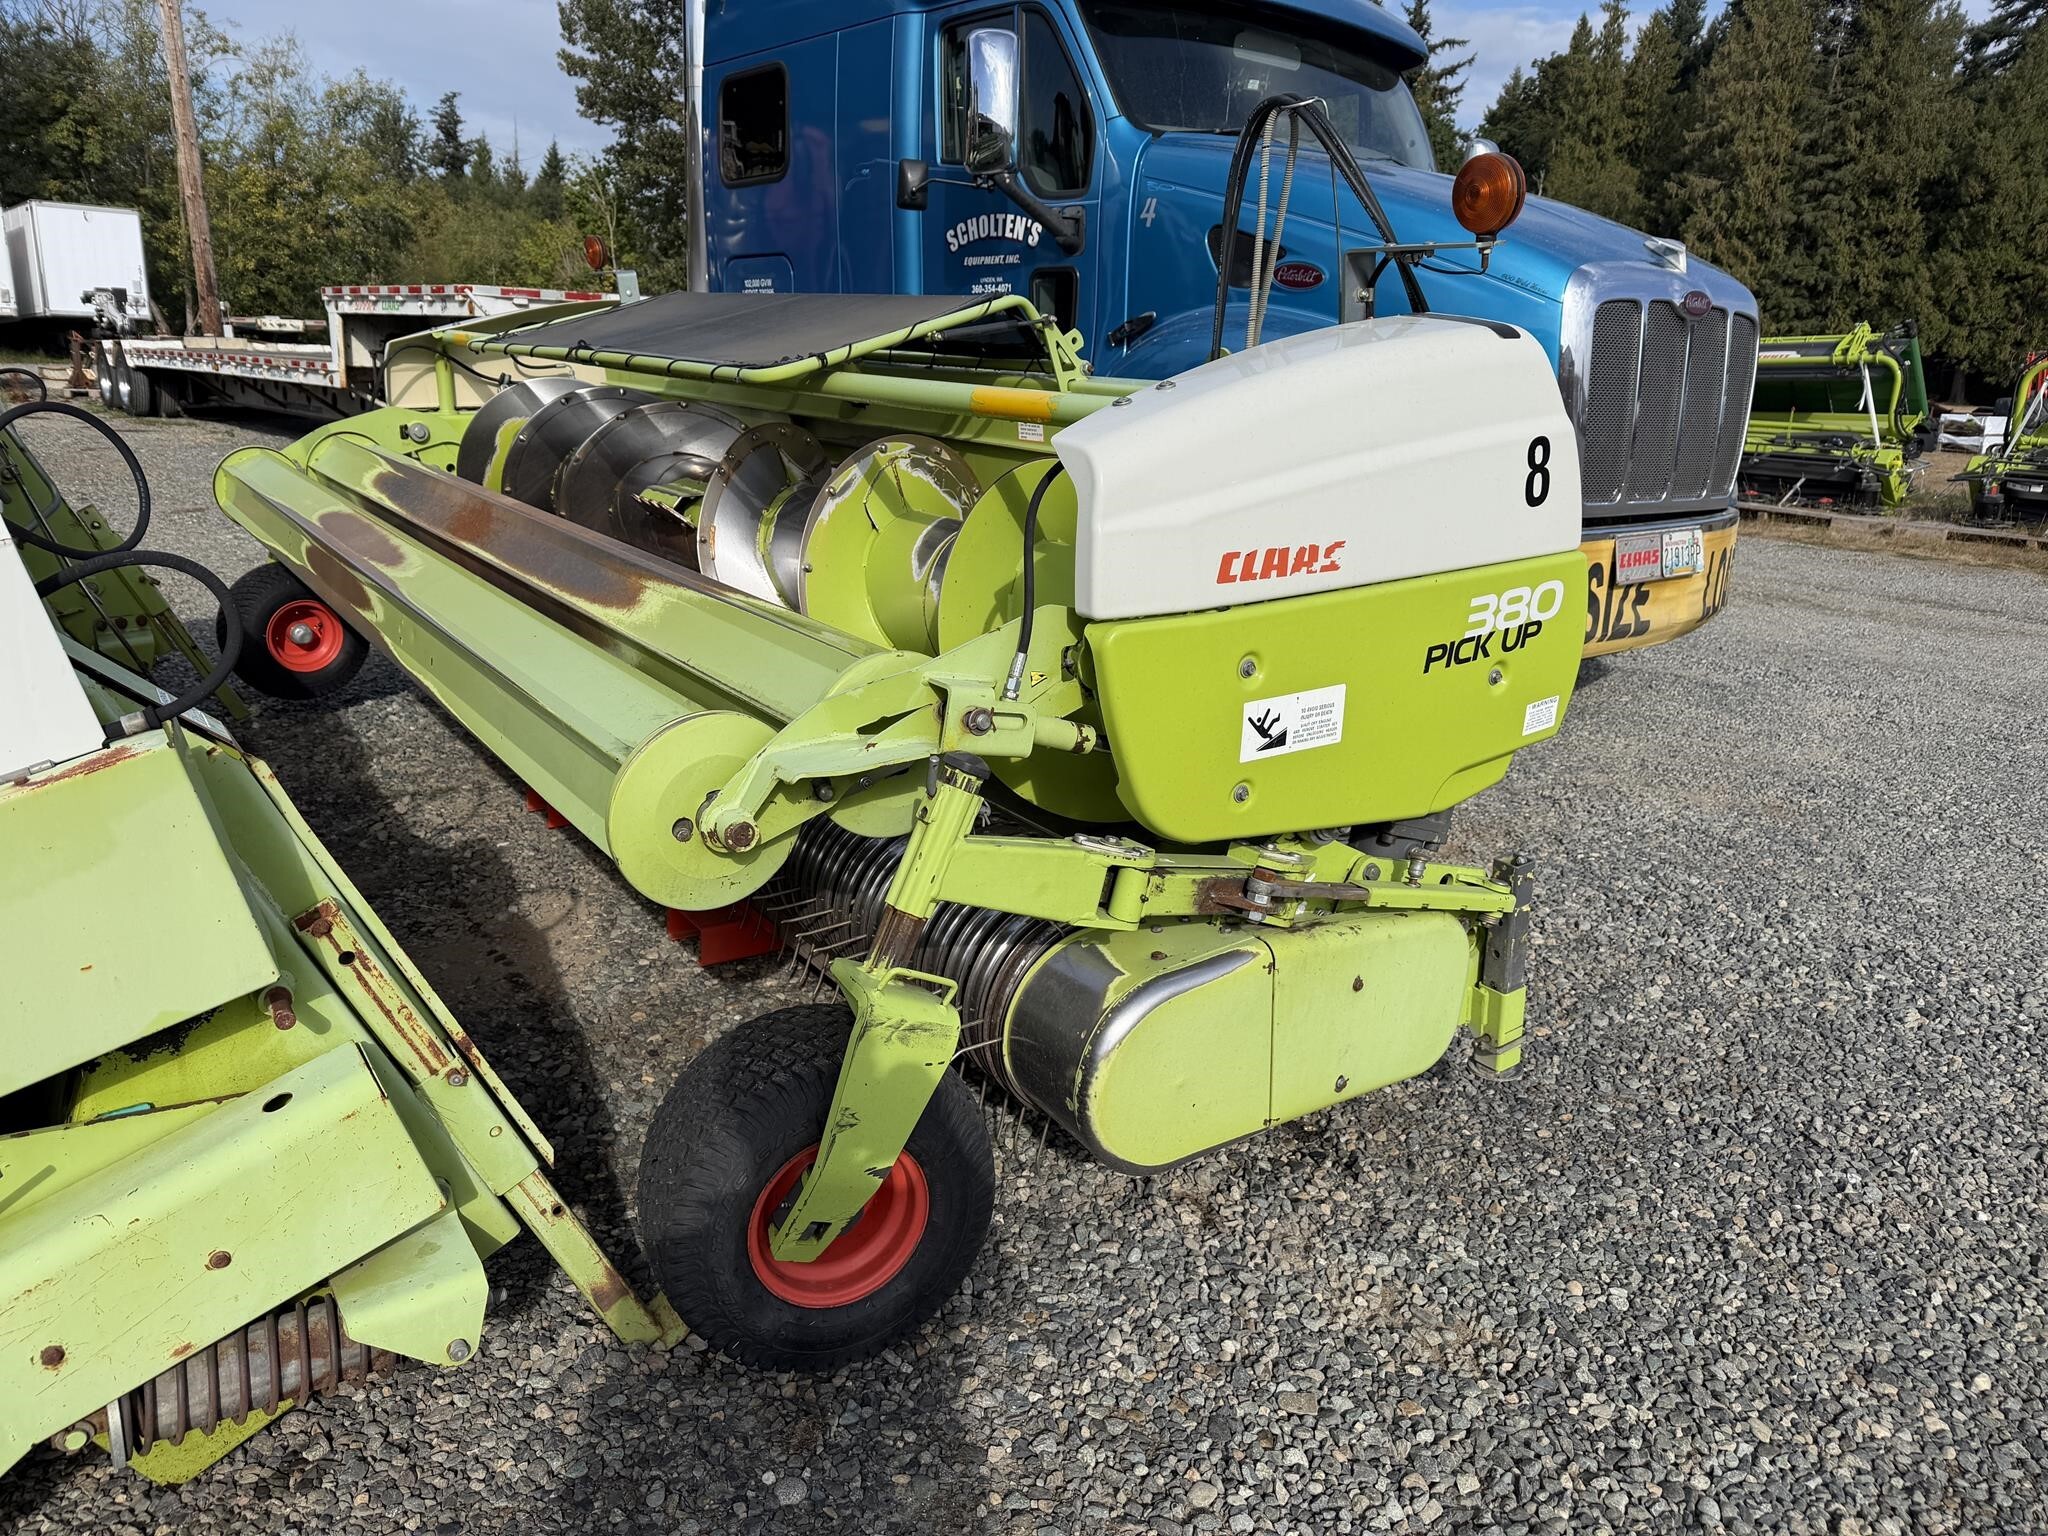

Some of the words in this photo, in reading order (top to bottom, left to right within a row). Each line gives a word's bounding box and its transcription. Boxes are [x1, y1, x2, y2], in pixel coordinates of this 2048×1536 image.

[1140, 197, 1157, 228] 4
[946, 213, 1043, 252] SCHOLTEN'S
[1005, 254, 1021, 264] INC.
[1277, 266, 1320, 282] Peterbilt
[971, 283, 1012, 294] 360-354-4071
[1525, 435, 1551, 508] 8
[1216, 540, 1347, 584] CLAAS
[1619, 548, 1660, 569] CLAAS
[1464, 579, 1565, 638] 380
[1423, 630, 1496, 674] PICK
[1500, 619, 1543, 654] UP
[1531, 696, 1558, 710] WARNING
